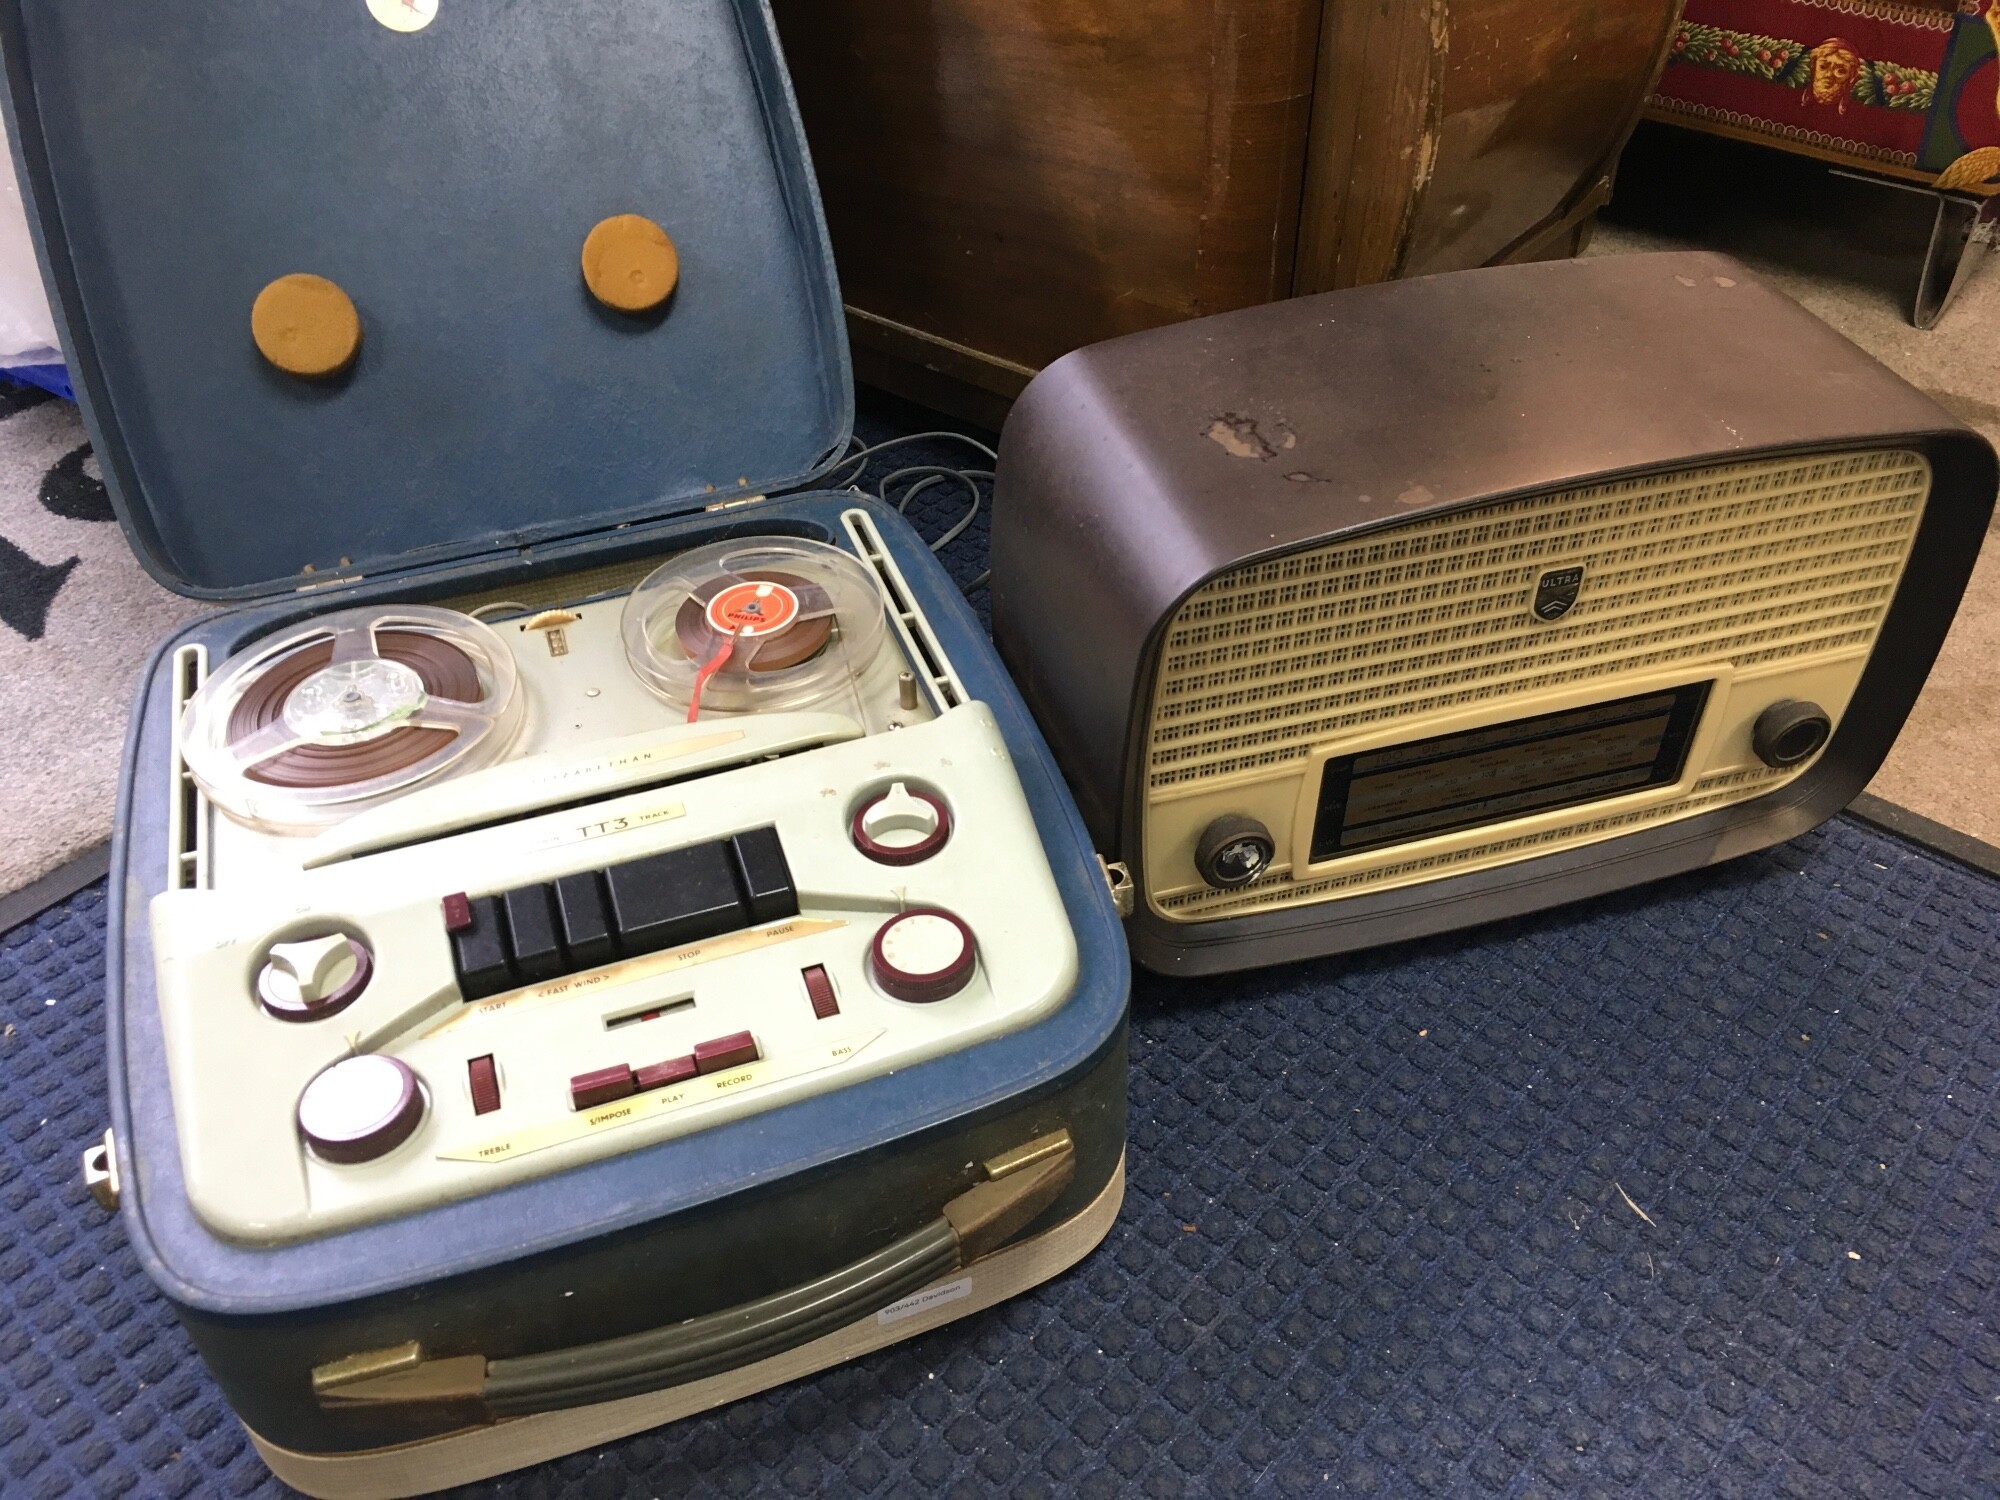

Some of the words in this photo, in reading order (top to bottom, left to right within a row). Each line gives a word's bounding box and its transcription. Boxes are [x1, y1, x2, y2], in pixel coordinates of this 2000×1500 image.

[1541, 573, 1580, 588] ULTRA
[727, 612, 766, 623] PHILIPS
[1377, 751, 1403, 763] 100
[1421, 743, 1440, 754] 98
[576, 817, 629, 838] TT3
[639, 809, 670, 821] TRACK
[766, 924, 795, 938] PAUSE
[677, 949, 702, 962] STOP
[546, 984, 569, 996] FAST
[573, 976, 602, 989] WIND
[478, 1001, 507, 1014] START
[832, 1046, 852, 1057] BASS
[716, 1074, 753, 1089] RECORD
[661, 1093, 685, 1105] PLAY
[589, 1107, 632, 1126] S/IMPOSE
[478, 1142, 511, 1157] TREBLE
[921, 1284, 961, 1303] Davidson
